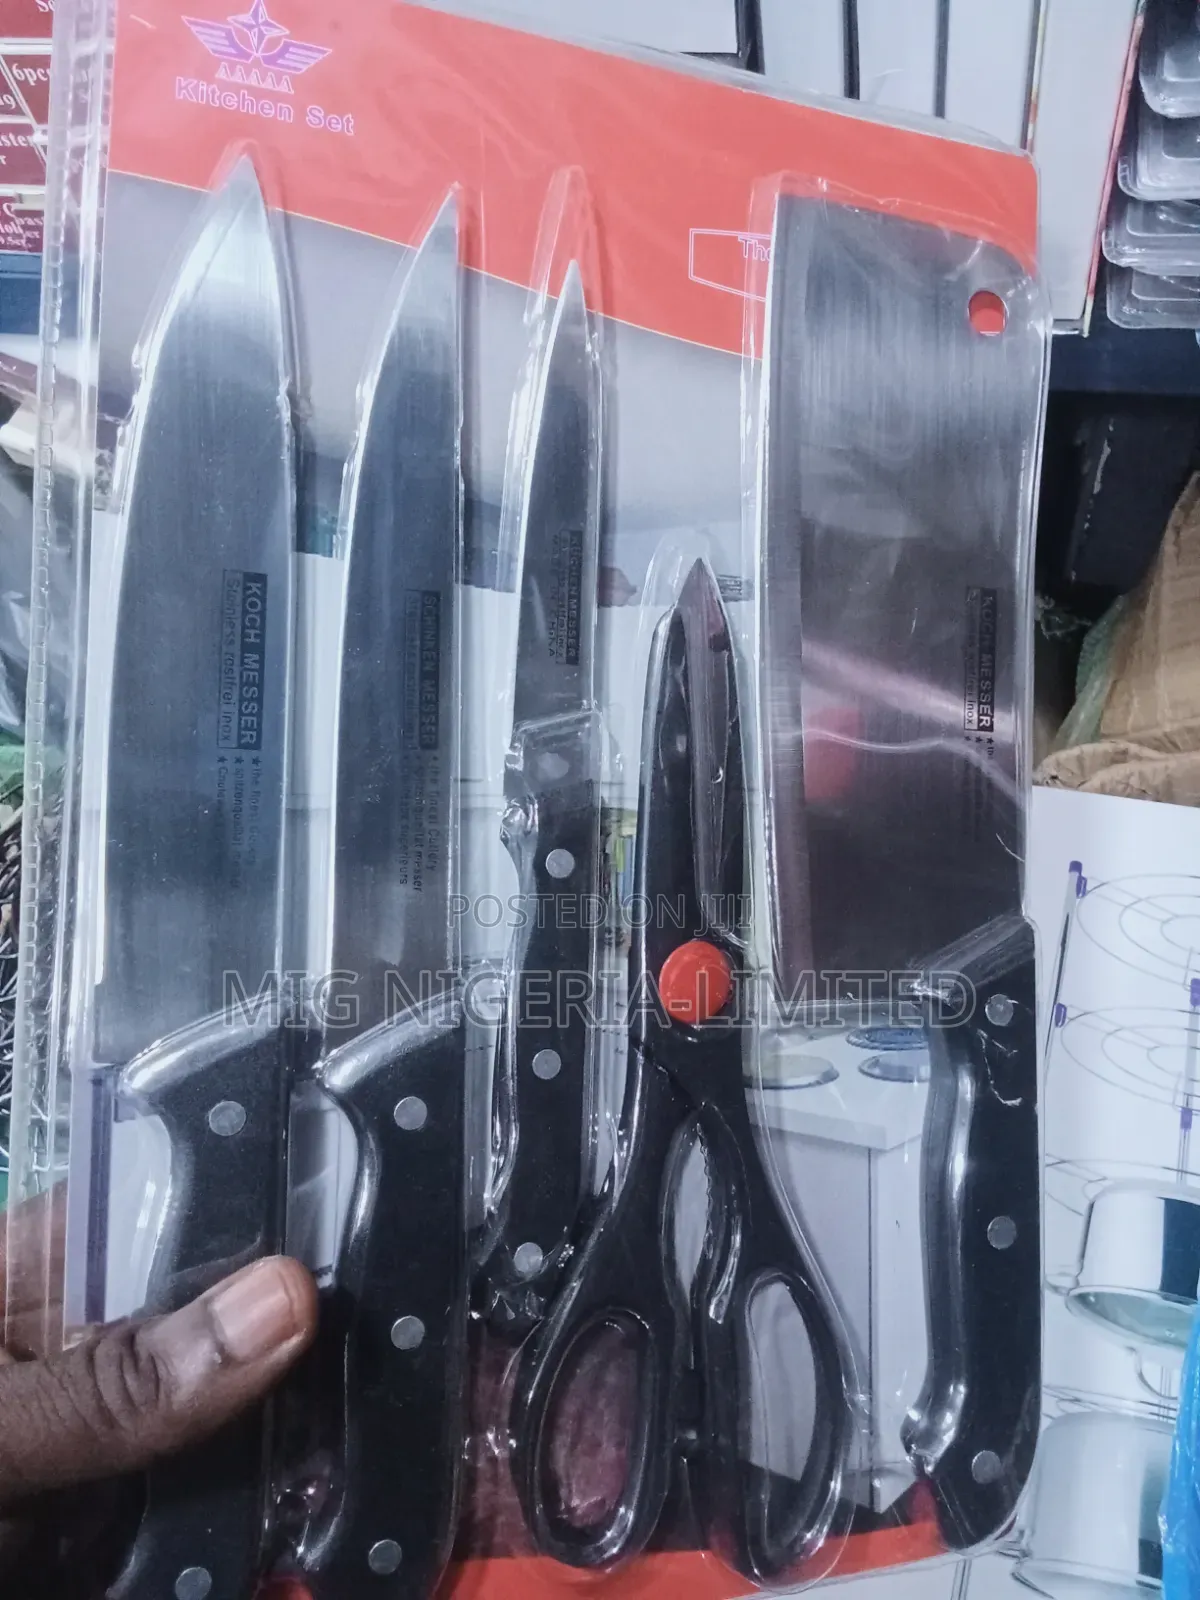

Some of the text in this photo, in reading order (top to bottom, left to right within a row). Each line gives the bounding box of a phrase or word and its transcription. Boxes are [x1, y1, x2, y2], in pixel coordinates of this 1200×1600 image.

[175, 76, 354, 136] Kitchen Set
[225, 578, 241, 646] Stainless
[568, 598, 578, 657] MESSER
[240, 582, 263, 744] KOCH MESSER
[420, 595, 438, 745] SCHINKEN MESSER
[979, 596, 994, 727] KOCH MESSER
[221, 711, 236, 741] inox
[966, 700, 977, 725] inox
